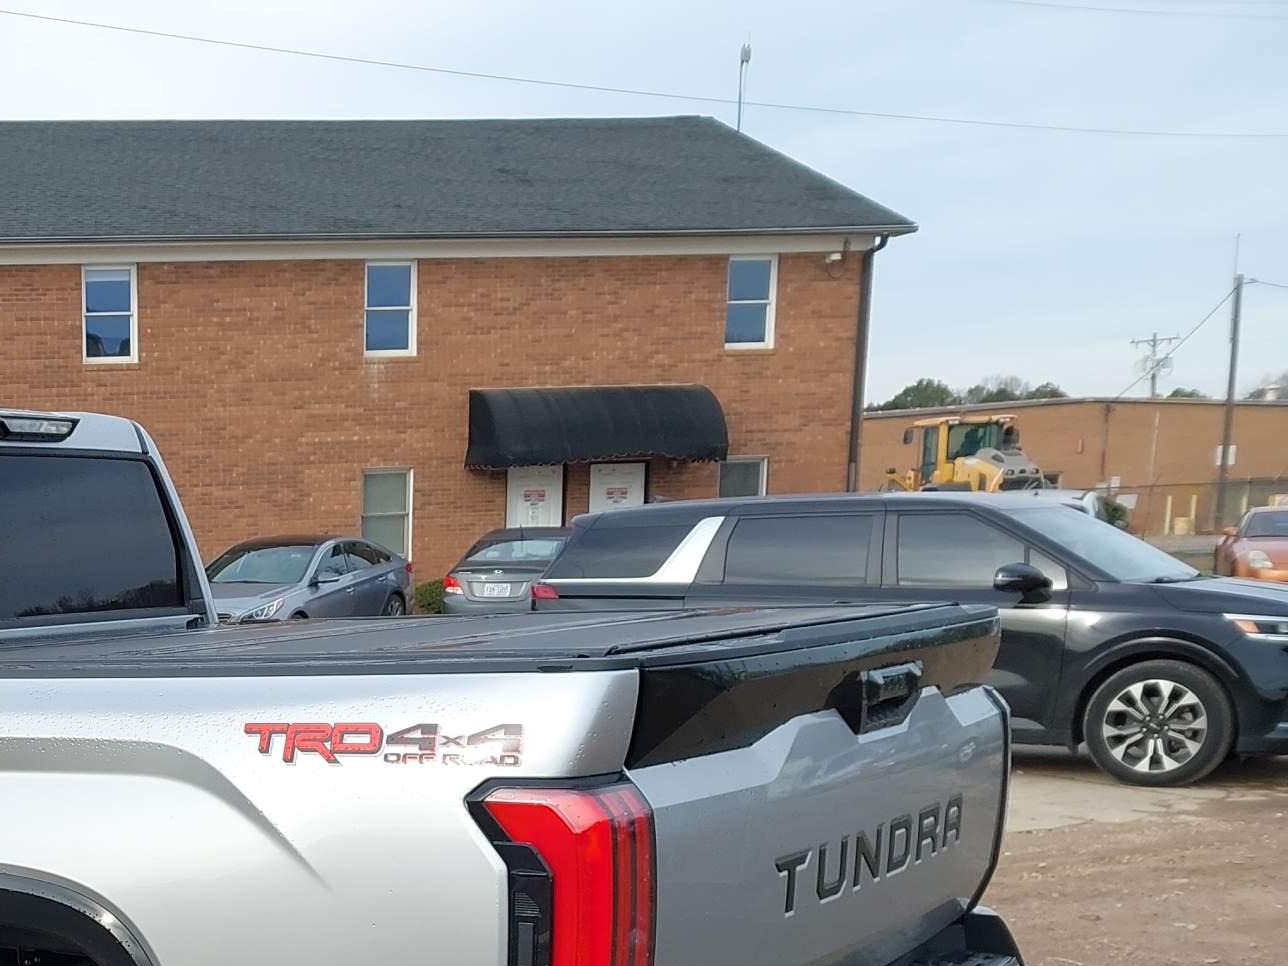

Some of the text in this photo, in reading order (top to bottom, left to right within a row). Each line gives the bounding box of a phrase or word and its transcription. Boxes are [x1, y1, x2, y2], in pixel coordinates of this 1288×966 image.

[244, 722, 523, 764] TRD 4x4
[383, 752, 520, 766] OFF RAD
[774, 792, 963, 917] TUNDRA
